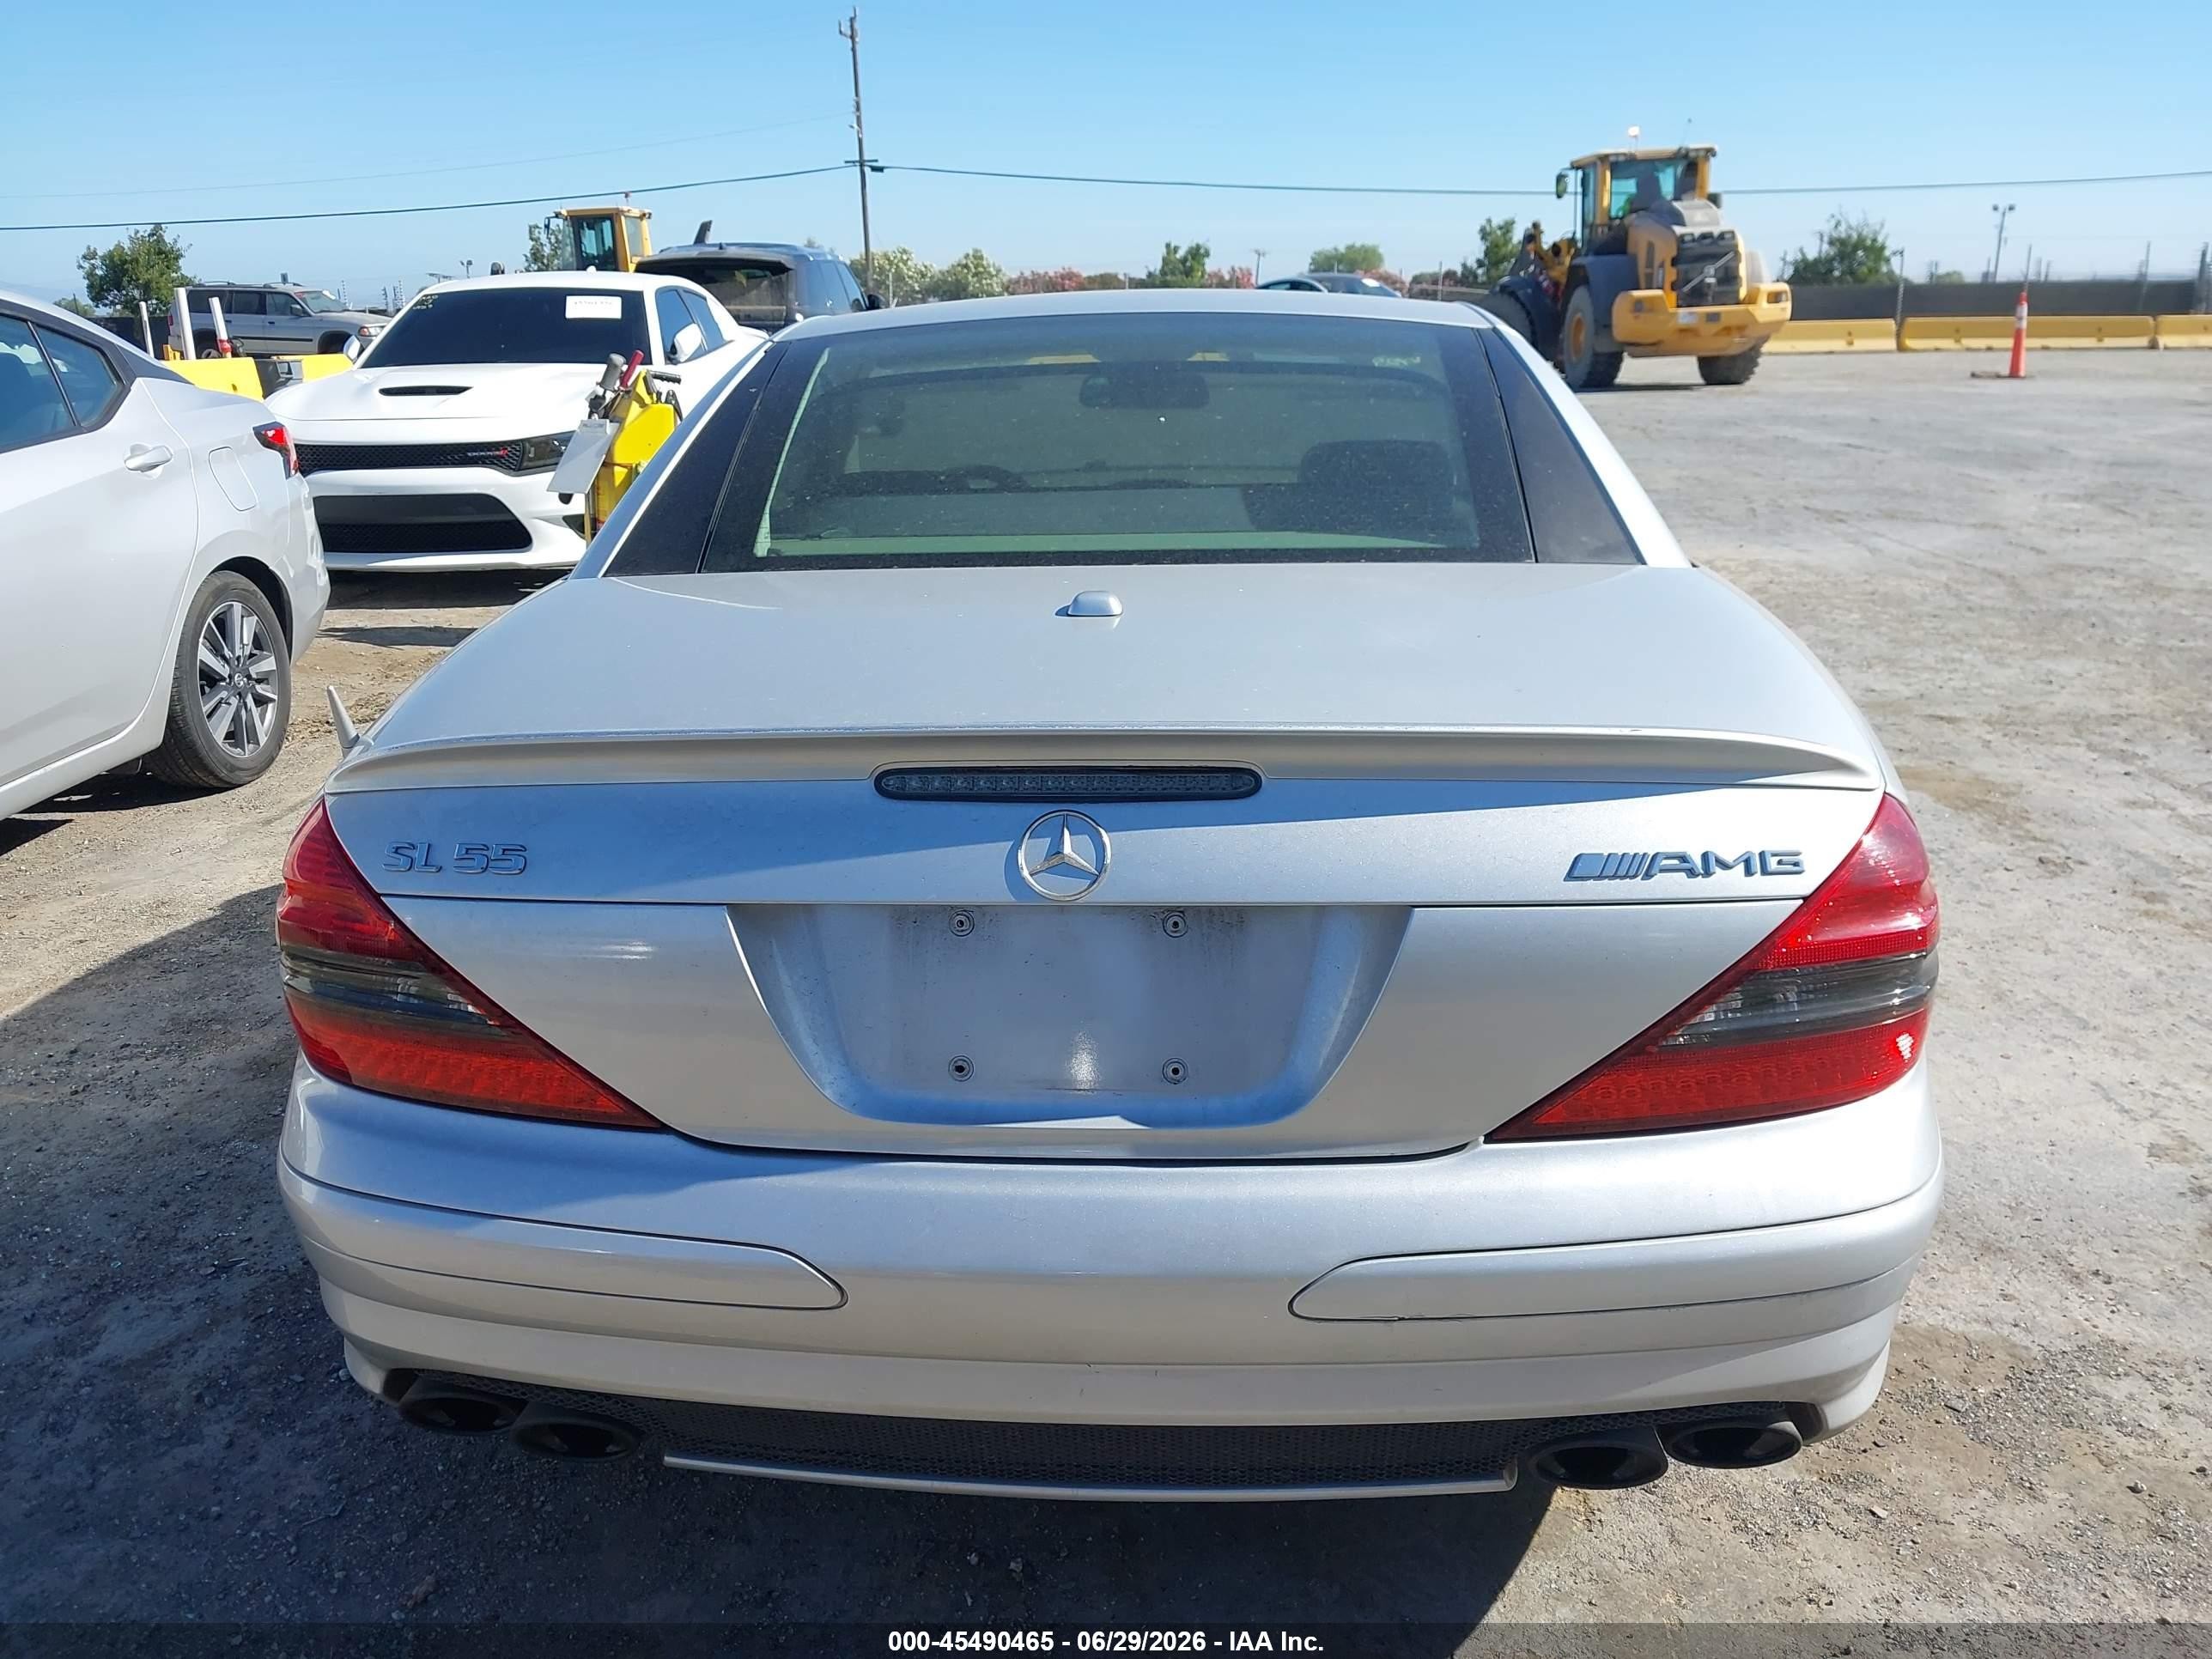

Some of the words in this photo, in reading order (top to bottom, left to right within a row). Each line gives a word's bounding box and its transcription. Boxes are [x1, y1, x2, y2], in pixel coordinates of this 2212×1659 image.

[382, 842, 442, 872] SL
[453, 842, 527, 875] 55
[1640, 850, 1805, 881] AMG
